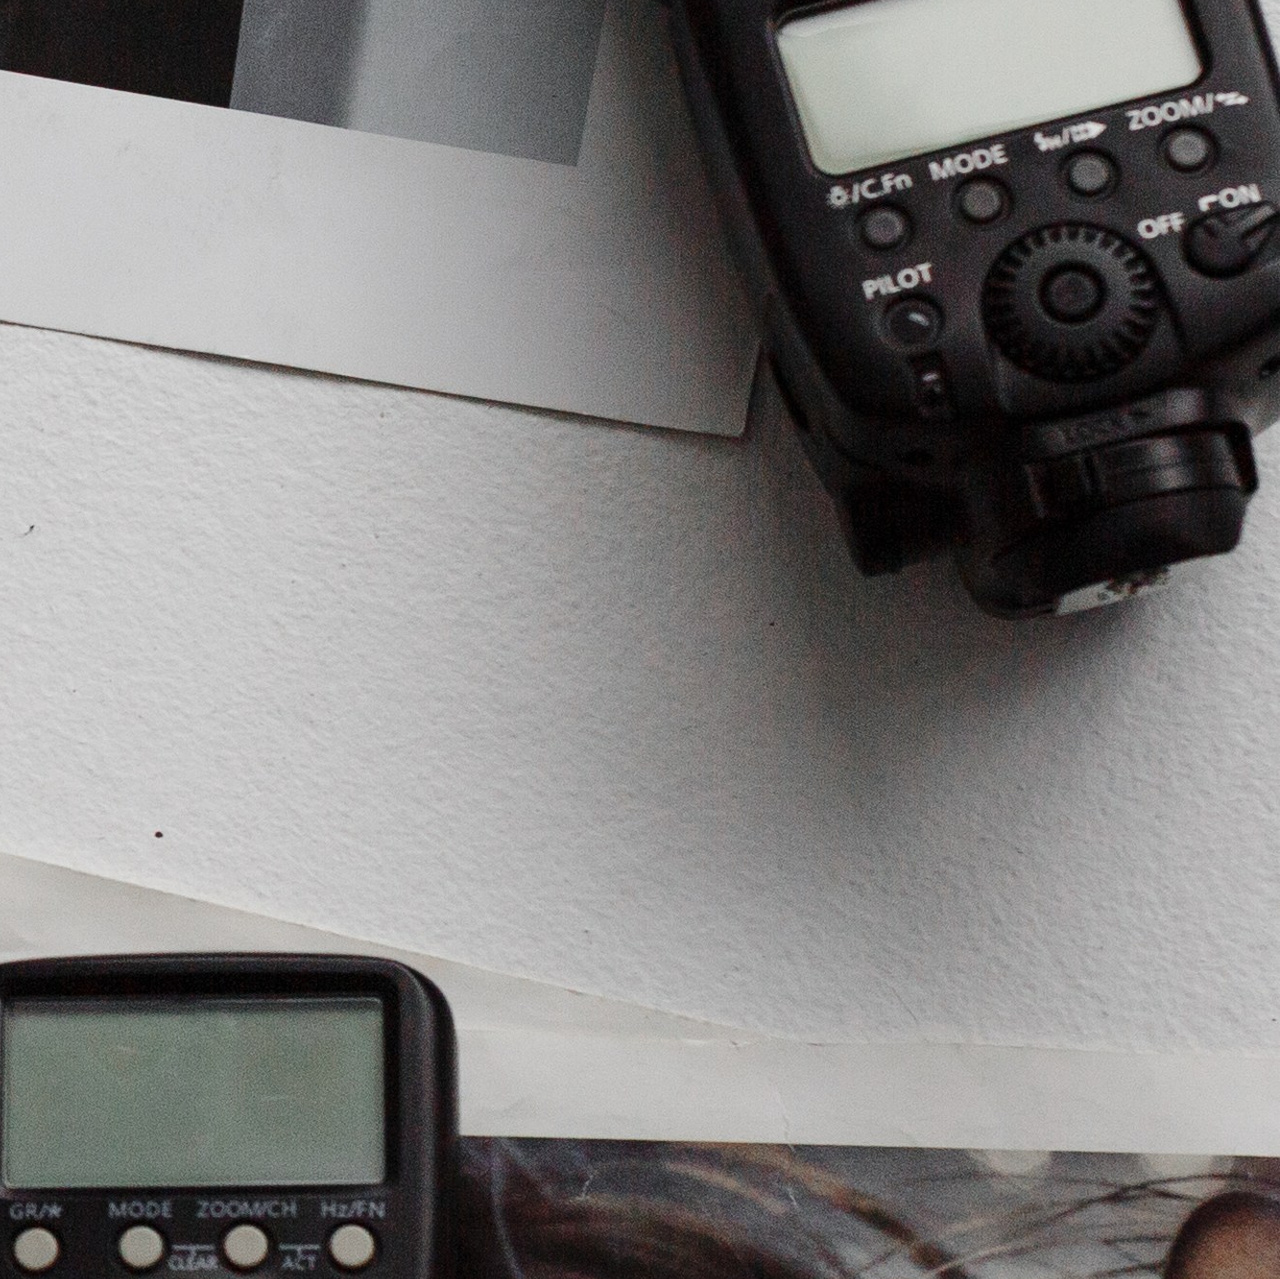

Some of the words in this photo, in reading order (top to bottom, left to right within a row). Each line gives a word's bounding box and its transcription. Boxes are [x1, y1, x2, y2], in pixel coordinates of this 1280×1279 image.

[928, 144, 1011, 181] MODE
[1219, 182, 1263, 209] ON
[1137, 211, 1186, 240] OFF
[861, 262, 933, 301] PILOT
[107, 1200, 173, 1219] MODE
[195, 1200, 298, 1219] ZOOM/CH
